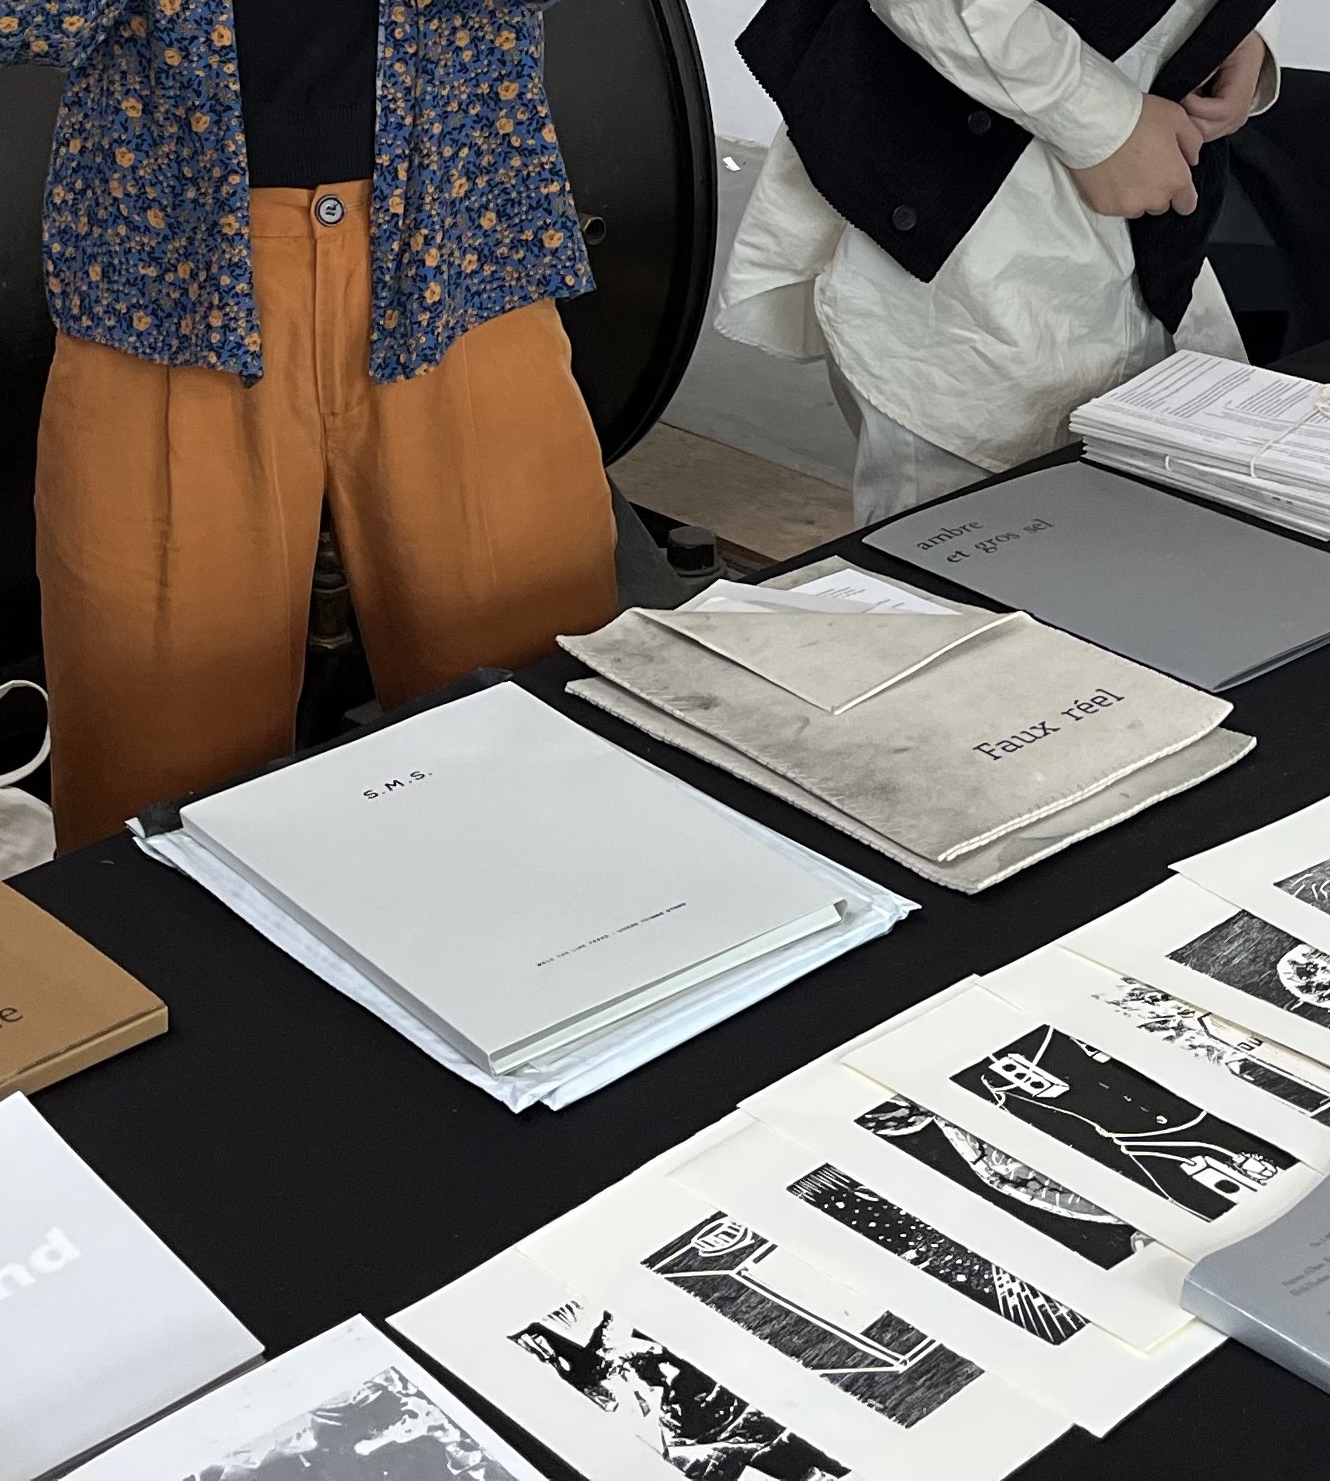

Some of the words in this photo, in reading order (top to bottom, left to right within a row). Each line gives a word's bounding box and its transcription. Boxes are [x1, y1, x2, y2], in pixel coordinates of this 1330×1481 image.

[916, 521, 984, 550] ambre
[946, 550, 971, 563] et
[974, 531, 1021, 554] gros
[1023, 518, 1055, 534] sel
[972, 721, 1061, 761] Faux
[1060, 688, 1125, 722] réel
